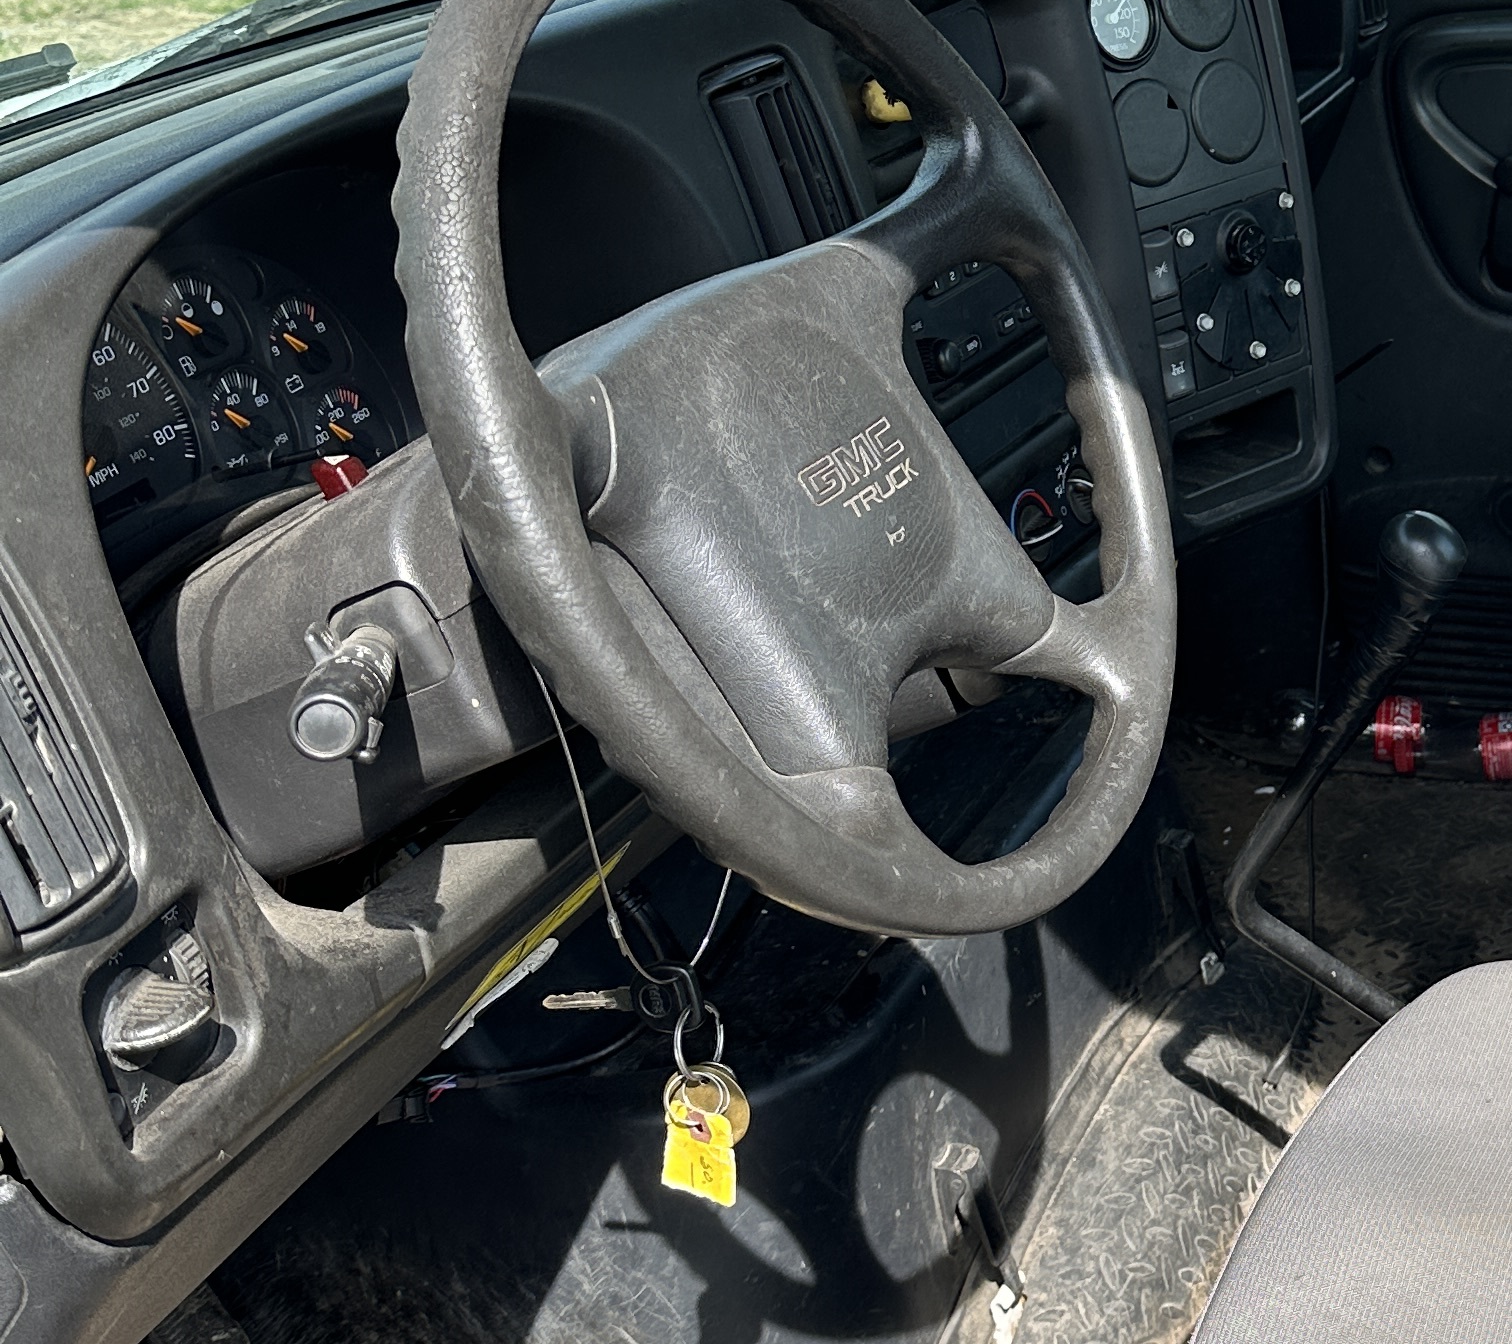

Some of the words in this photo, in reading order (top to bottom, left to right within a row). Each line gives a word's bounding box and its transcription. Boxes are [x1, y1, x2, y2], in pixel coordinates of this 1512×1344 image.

[1113, 26, 1130, 39] 150
[949, 271, 956, 281] 2
[92, 345, 116, 366] 60
[271, 345, 280, 356] 9
[93, 386, 112, 401] 100
[126, 377, 150, 398] 70
[226, 393, 241, 406] 40
[119, 413, 137, 428] 120
[328, 407, 344, 422] 210
[351, 407, 370, 424] 260
[153, 424, 176, 446] 80
[274, 432, 289, 446] PSI
[797, 416, 905, 507] GMC
[88, 462, 119, 488] MPH
[843, 457, 919, 518] TRUCK
